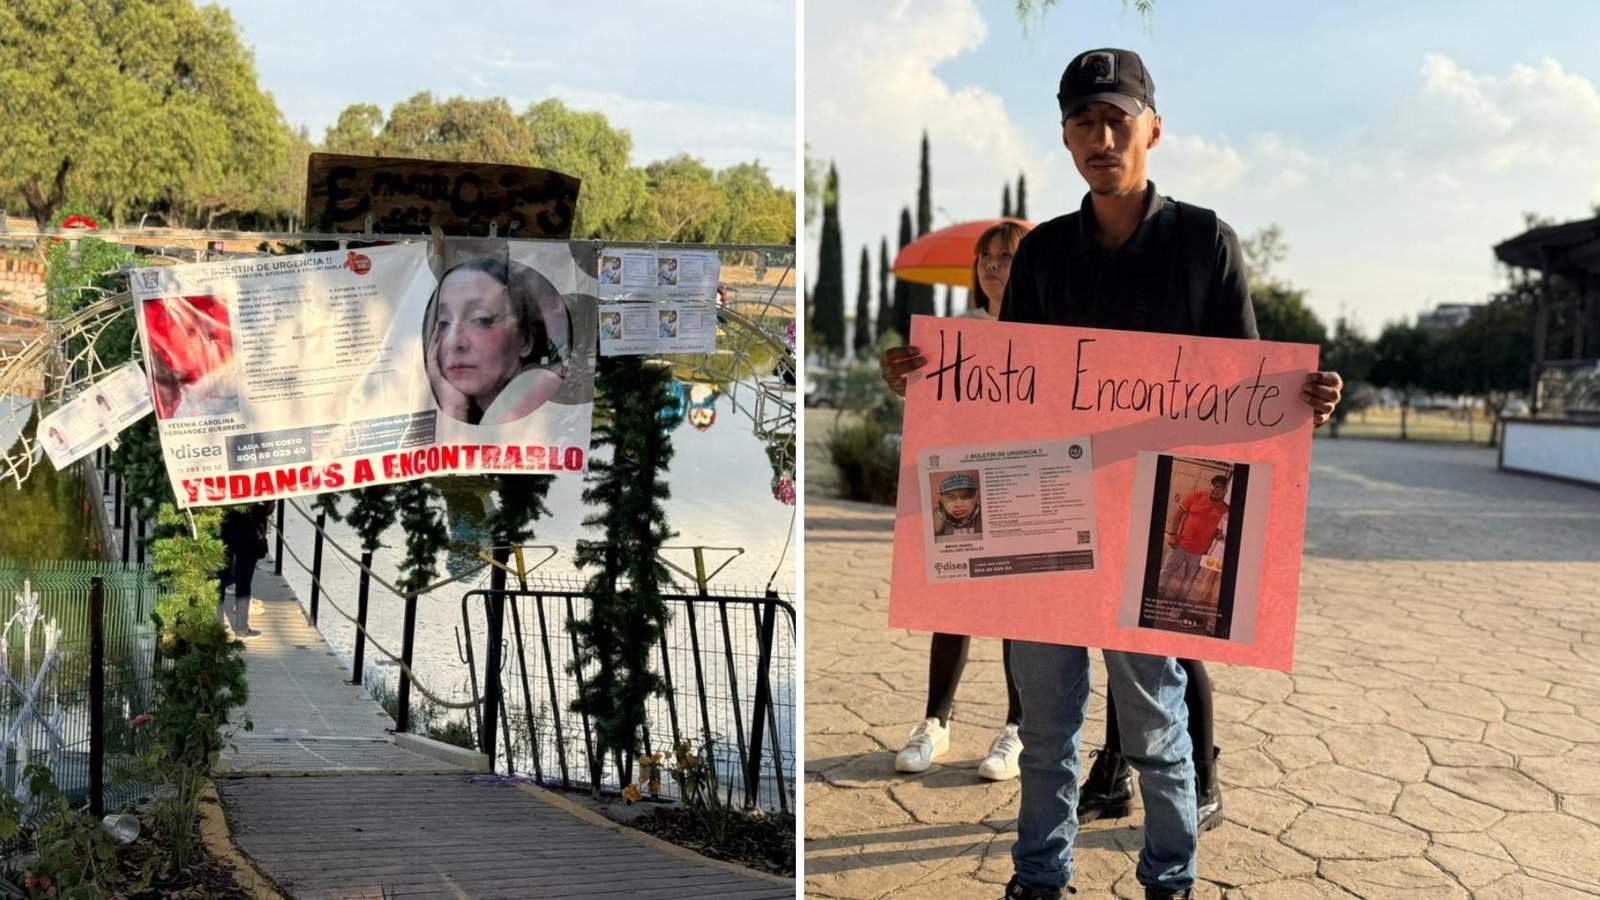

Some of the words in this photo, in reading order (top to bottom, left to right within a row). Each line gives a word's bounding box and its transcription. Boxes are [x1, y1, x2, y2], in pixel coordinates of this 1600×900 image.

[211, 263, 253, 276] BOLETÍN
[256, 262, 271, 271] DE
[272, 257, 323, 270] URGENCIA
[925, 329, 1036, 405] Hasta
[1070, 338, 1286, 427] Encontrarte
[167, 421, 197, 430] YESENIA
[198, 417, 235, 427] CAROLINA
[208, 423, 246, 434] GUERRERO
[171, 443, 222, 460] disea
[237, 444, 260, 452] LADA
[260, 441, 274, 449] SIN
[275, 438, 302, 446] COSTO
[292, 446, 306, 455] 40
[353, 457, 375, 485] A
[382, 444, 584, 479] ENCONTRARLO
